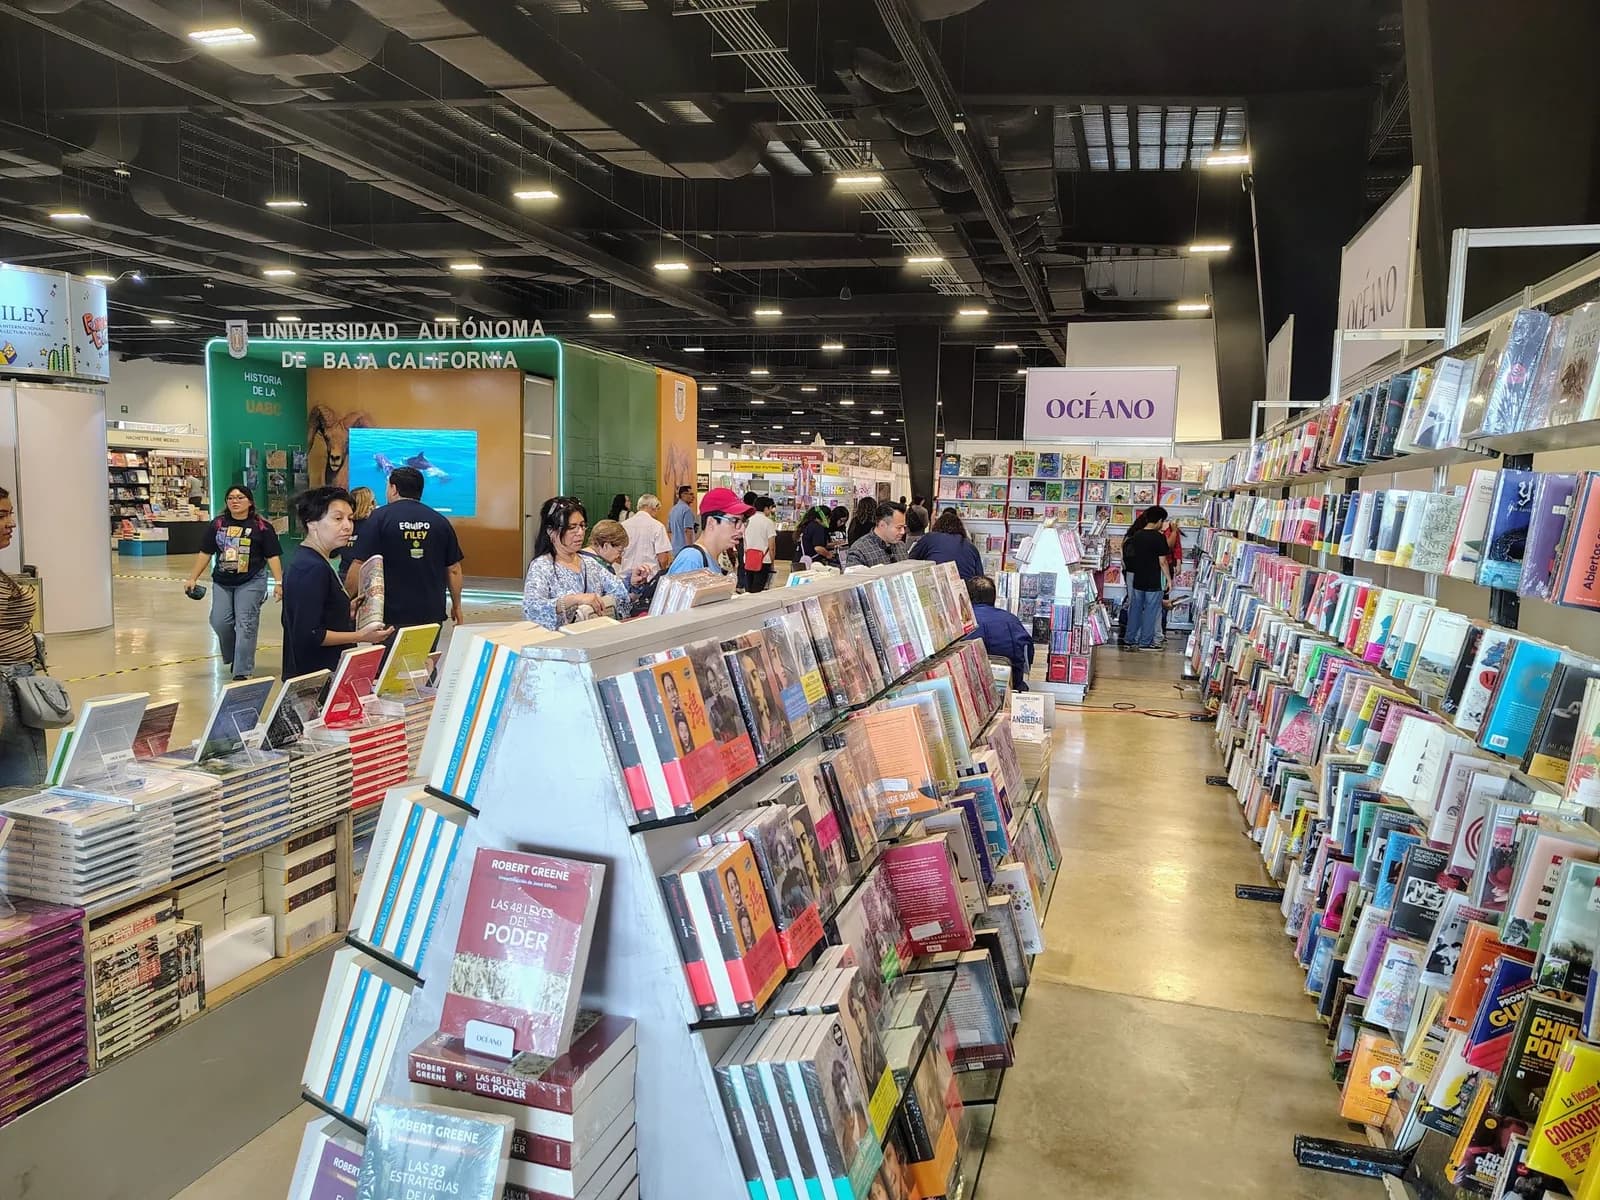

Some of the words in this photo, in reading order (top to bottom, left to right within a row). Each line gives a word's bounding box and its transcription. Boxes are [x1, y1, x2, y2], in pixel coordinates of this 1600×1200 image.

[262, 322, 399, 340] UNIVERSIDAD
[418, 316, 546, 339] AUTÓNOMA
[281, 351, 307, 369] DE
[323, 352, 379, 370] BAJA
[388, 350, 519, 369] CALIFORNIA
[244, 371, 282, 385] HISTORIA
[252, 385, 264, 396] DE
[265, 387, 276, 397] LA
[1046, 391, 1155, 419] OCÉANO
[399, 521, 430, 530] EQUIPO
[491, 859, 530, 874] ROBERT
[531, 866, 570, 881] GREENE
[491, 899, 509, 911] LAS
[510, 903, 521, 913] 48
[523, 904, 553, 919] LEYES
[510, 915, 528, 928] DEL
[484, 922, 549, 952] PODER
[415, 1062, 446, 1073] ROBERT
[416, 1070, 446, 1082] GREENE
[475, 1073, 490, 1083] LAS
[491, 1075, 501, 1085] 48
[502, 1078, 526, 1090] LEYES
[476, 1082, 491, 1093] DEL
[492, 1084, 526, 1099] PODER
[392, 1119, 434, 1135] ROBERT
[435, 1126, 479, 1144] GREENE
[333, 1157, 361, 1177] ROBERT
[408, 1160, 429, 1173] LAS
[431, 1164, 446, 1177] 33
[390, 1170, 459, 1195] ESTRATEGIAS
